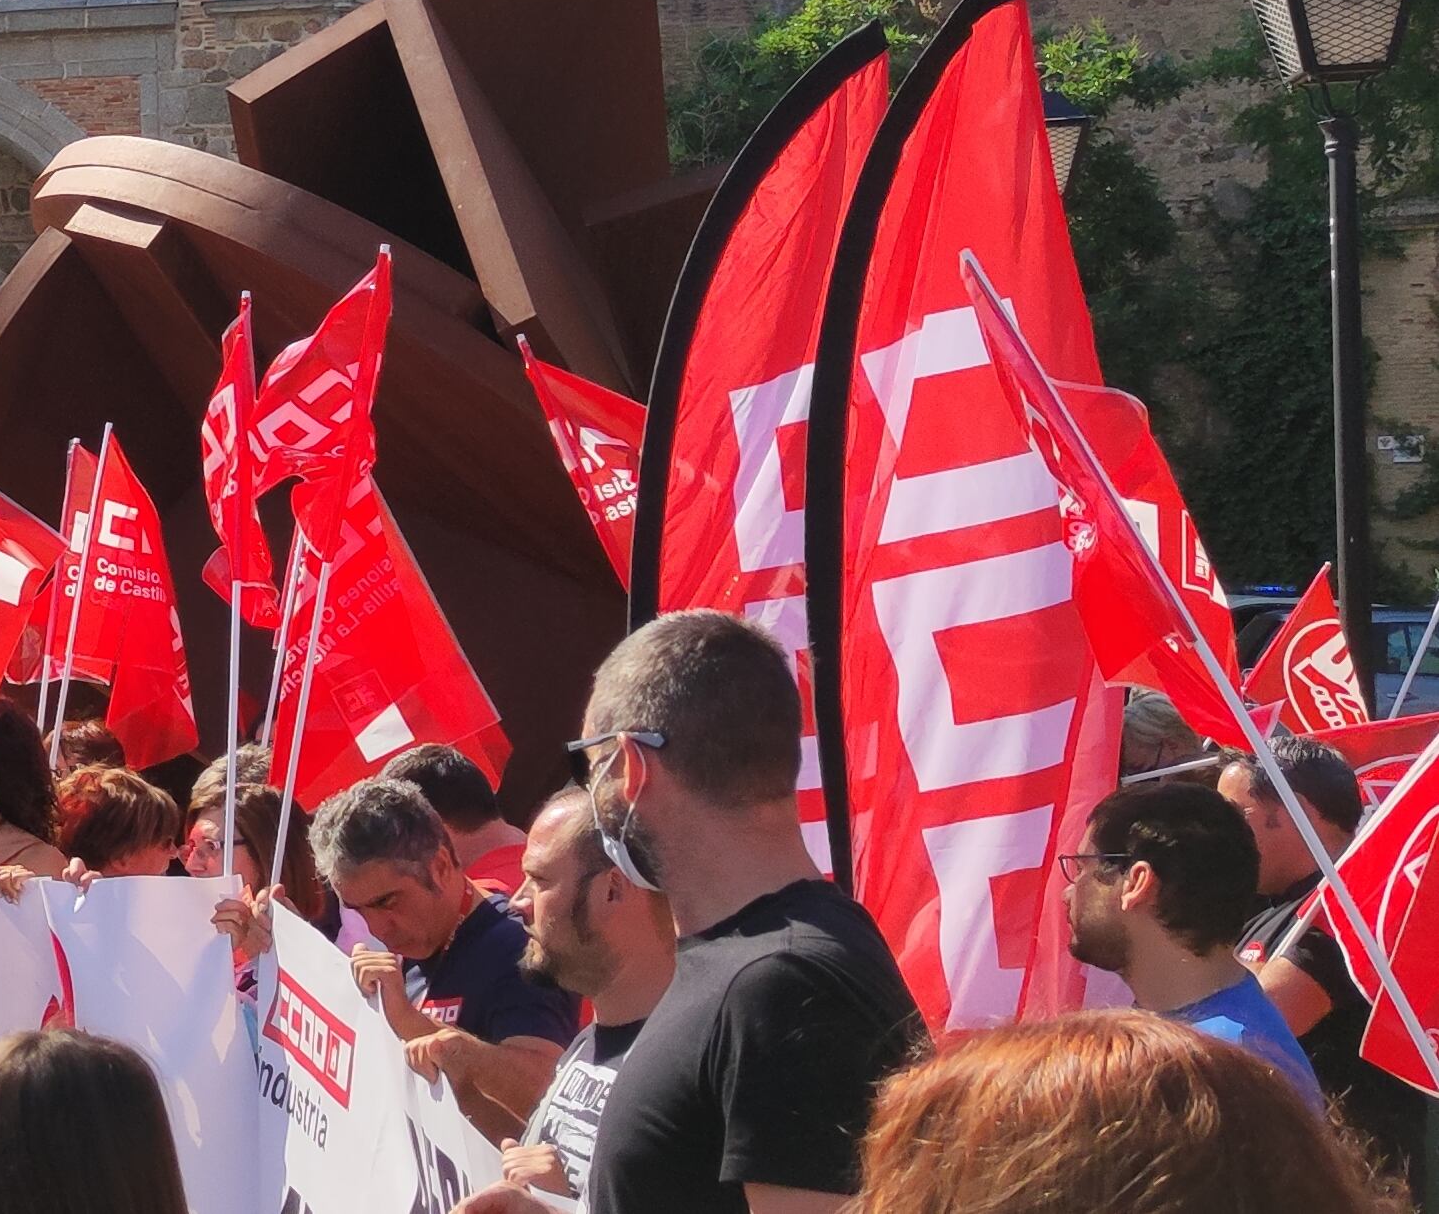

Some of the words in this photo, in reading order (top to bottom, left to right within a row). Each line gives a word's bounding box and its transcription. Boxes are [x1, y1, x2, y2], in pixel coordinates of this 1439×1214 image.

[93, 574, 116, 592] de
[96, 556, 163, 585] Comisio
[254, 1046, 328, 1152] industria
